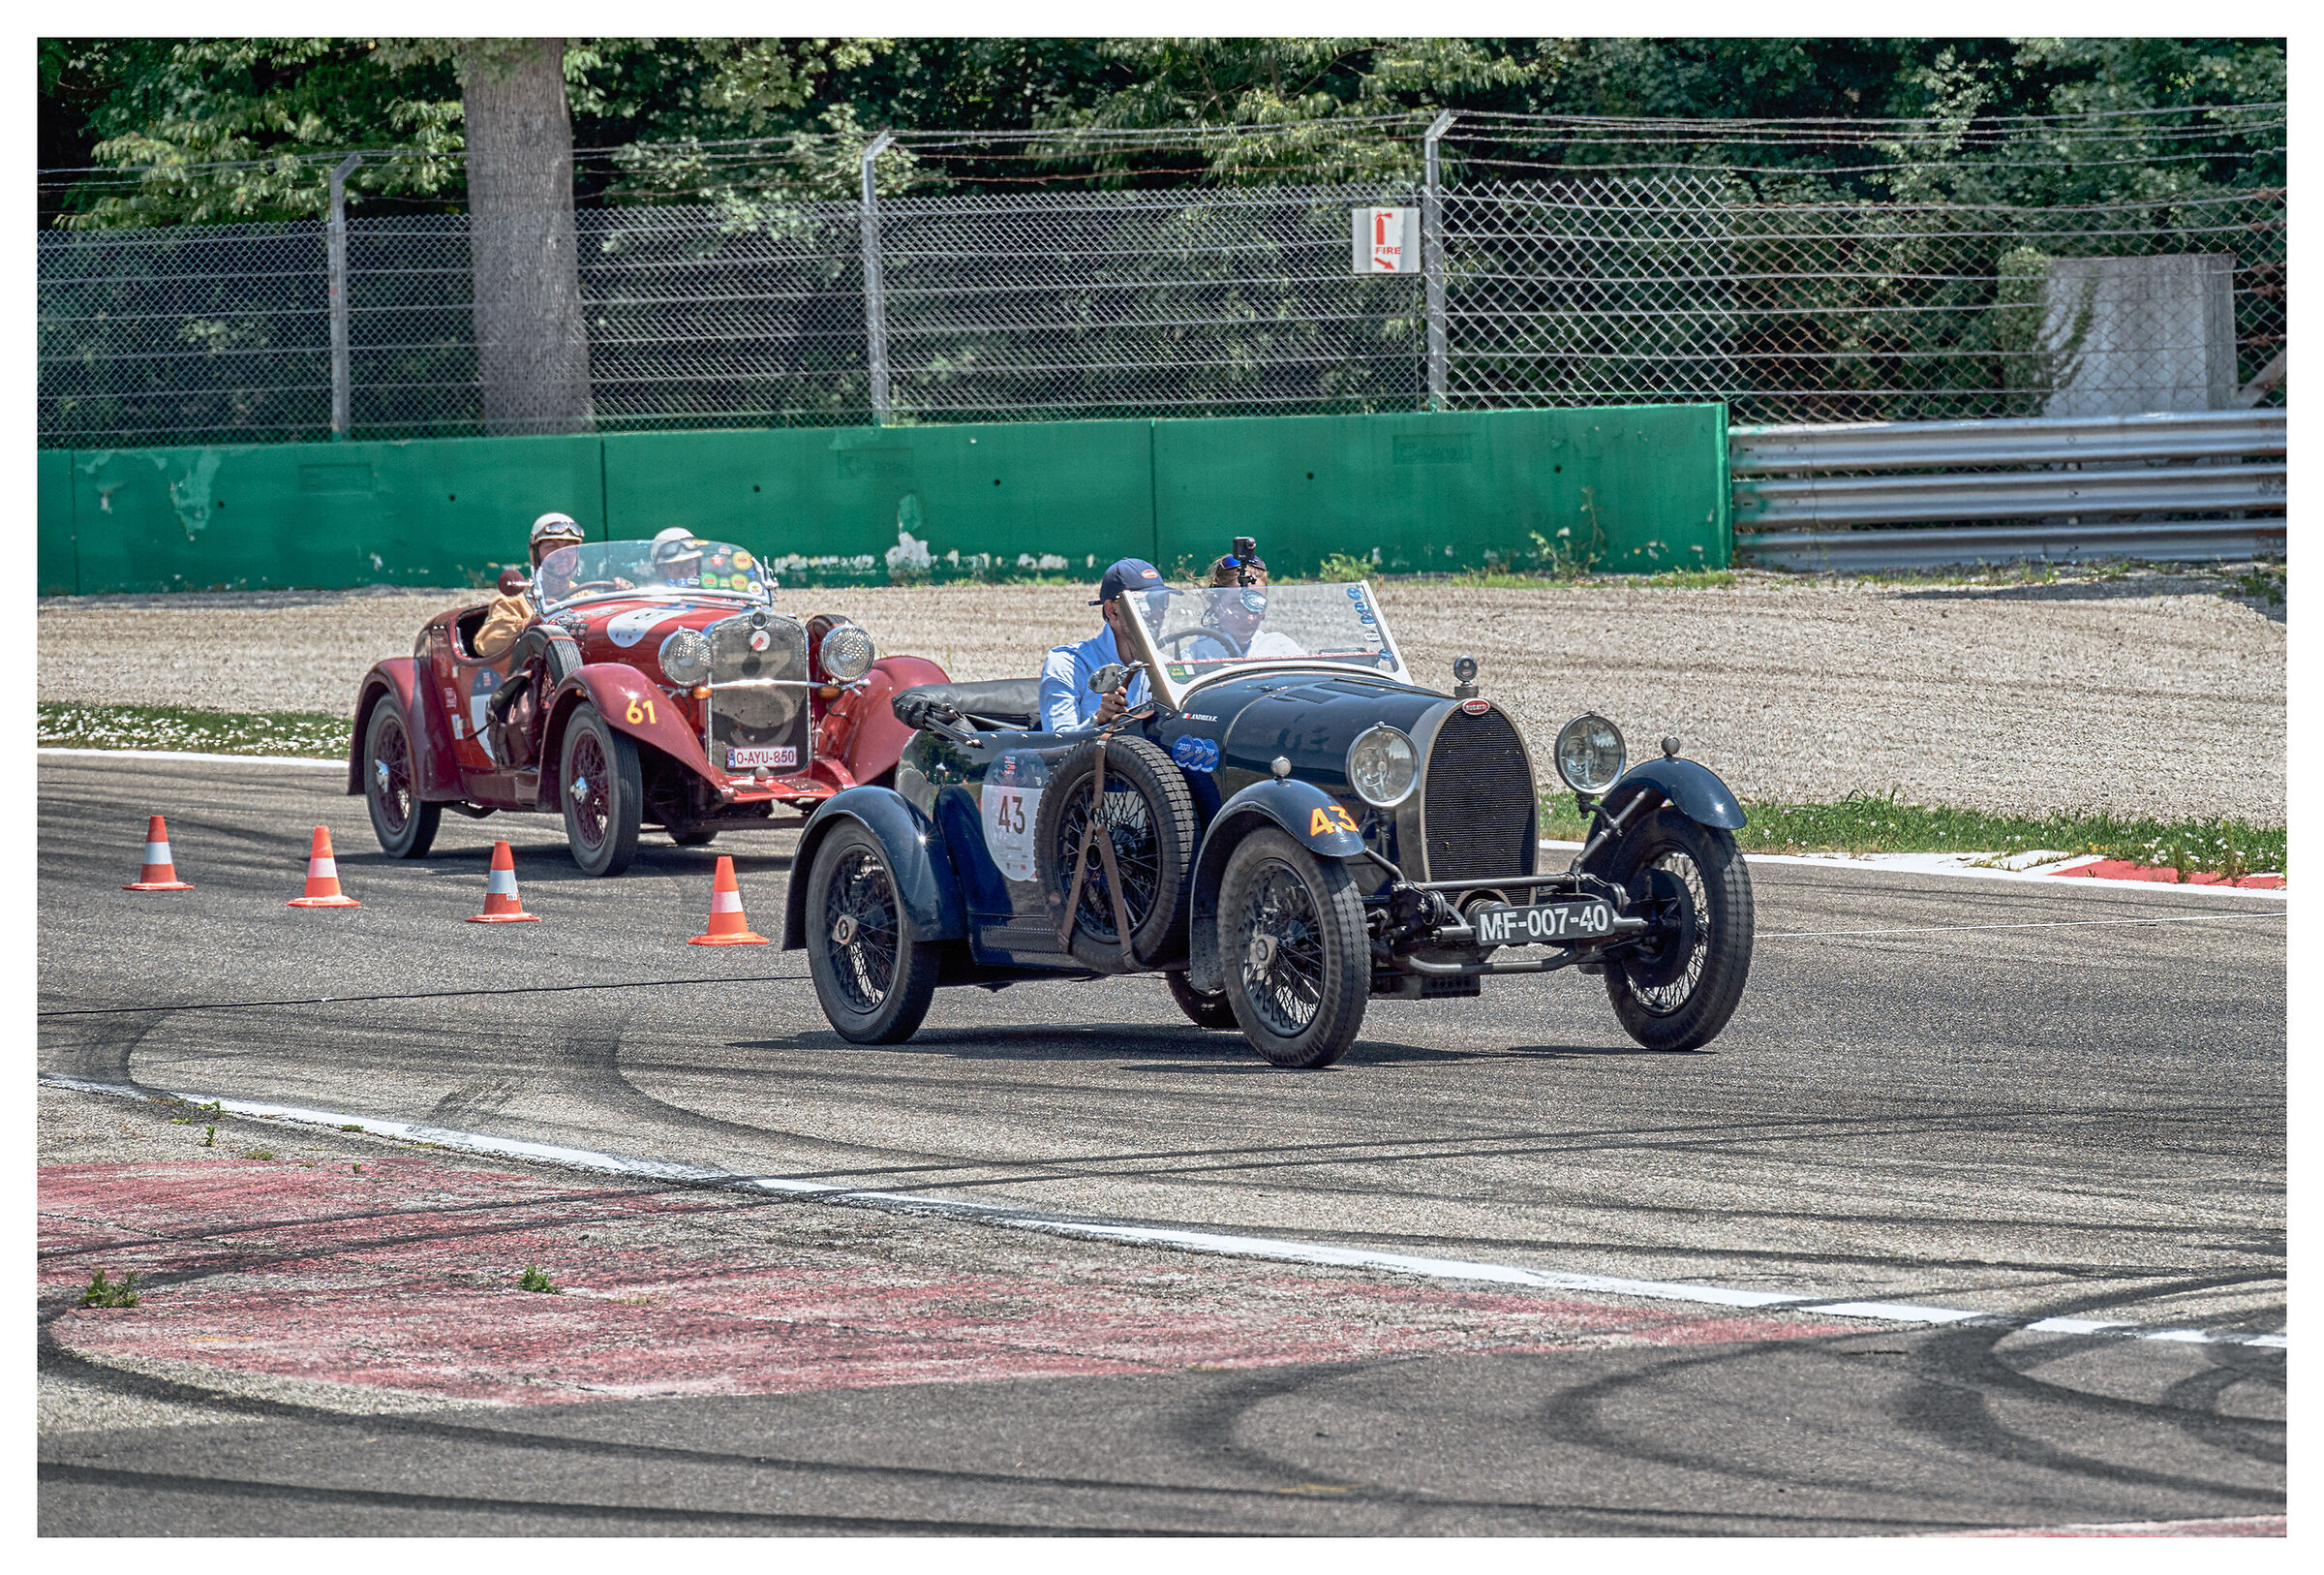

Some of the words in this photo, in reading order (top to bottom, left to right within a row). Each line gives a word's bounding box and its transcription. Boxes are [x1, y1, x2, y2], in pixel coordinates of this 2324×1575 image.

[1375, 246, 1401, 255] FIRE
[627, 697, 657, 725] 61
[736, 750, 795, 764] O-AYU-850
[998, 795, 1025, 835] 43
[1310, 805, 1358, 836] 43
[1479, 905, 1609, 942] MF-007-40
